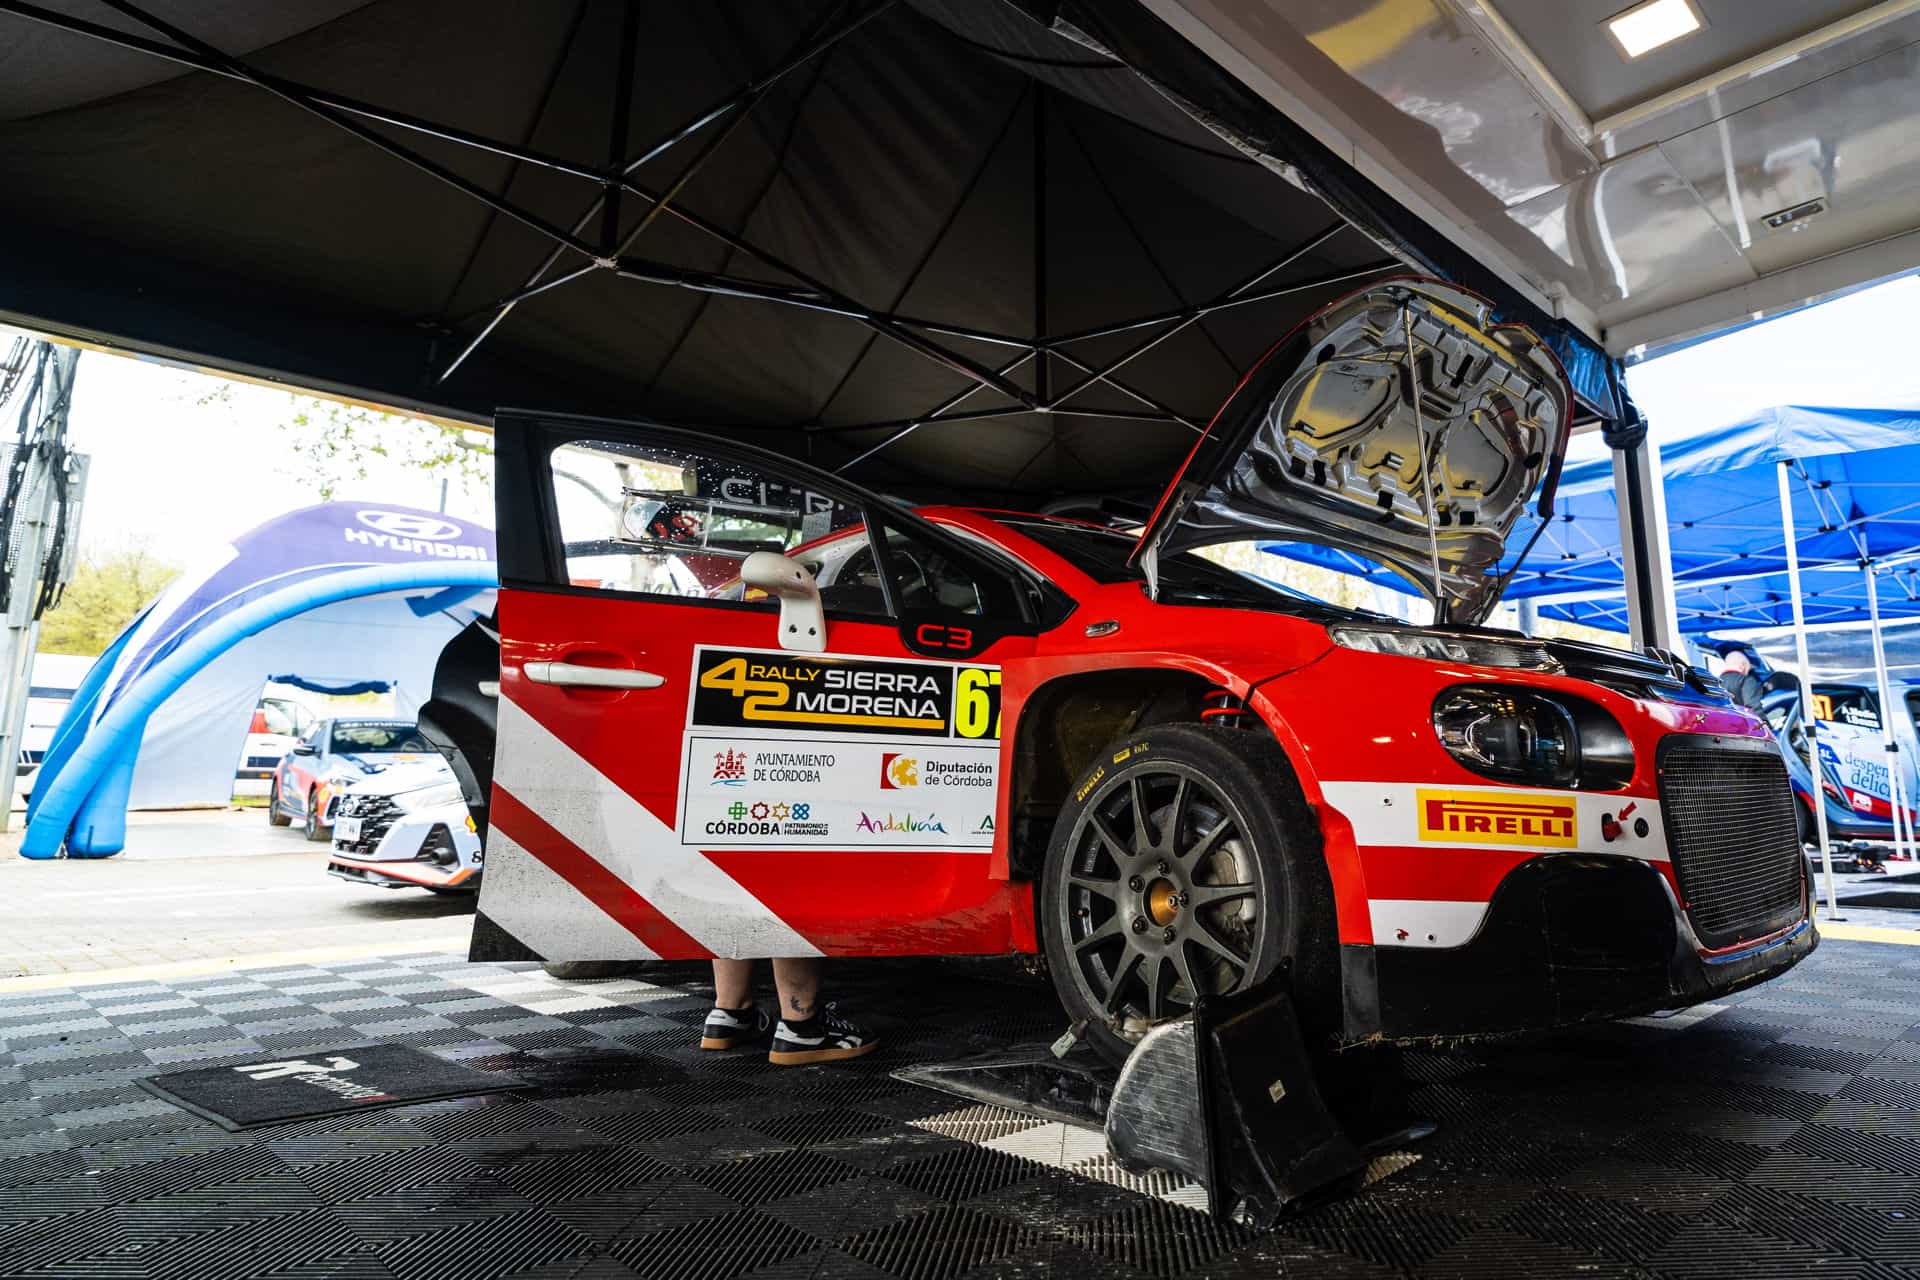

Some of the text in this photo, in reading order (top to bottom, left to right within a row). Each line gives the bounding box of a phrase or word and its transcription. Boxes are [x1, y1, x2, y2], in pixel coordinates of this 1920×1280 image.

[344, 527, 488, 561] HYUNDAI
[916, 623, 972, 650] C3
[750, 665, 821, 681] RALLY
[824, 669, 941, 695] SIERRA
[795, 692, 941, 718] MORENA
[754, 753, 836, 767] AYUNTAMIENTO
[926, 760, 993, 775] Diputación
[753, 767, 821, 783] DE CÓRDOBA
[925, 775, 993, 787] de Córdoba
[705, 820, 780, 835] CÓRDOBA
[856, 811, 950, 835] Andalucía
[1425, 799, 1574, 838] PIRELLI
